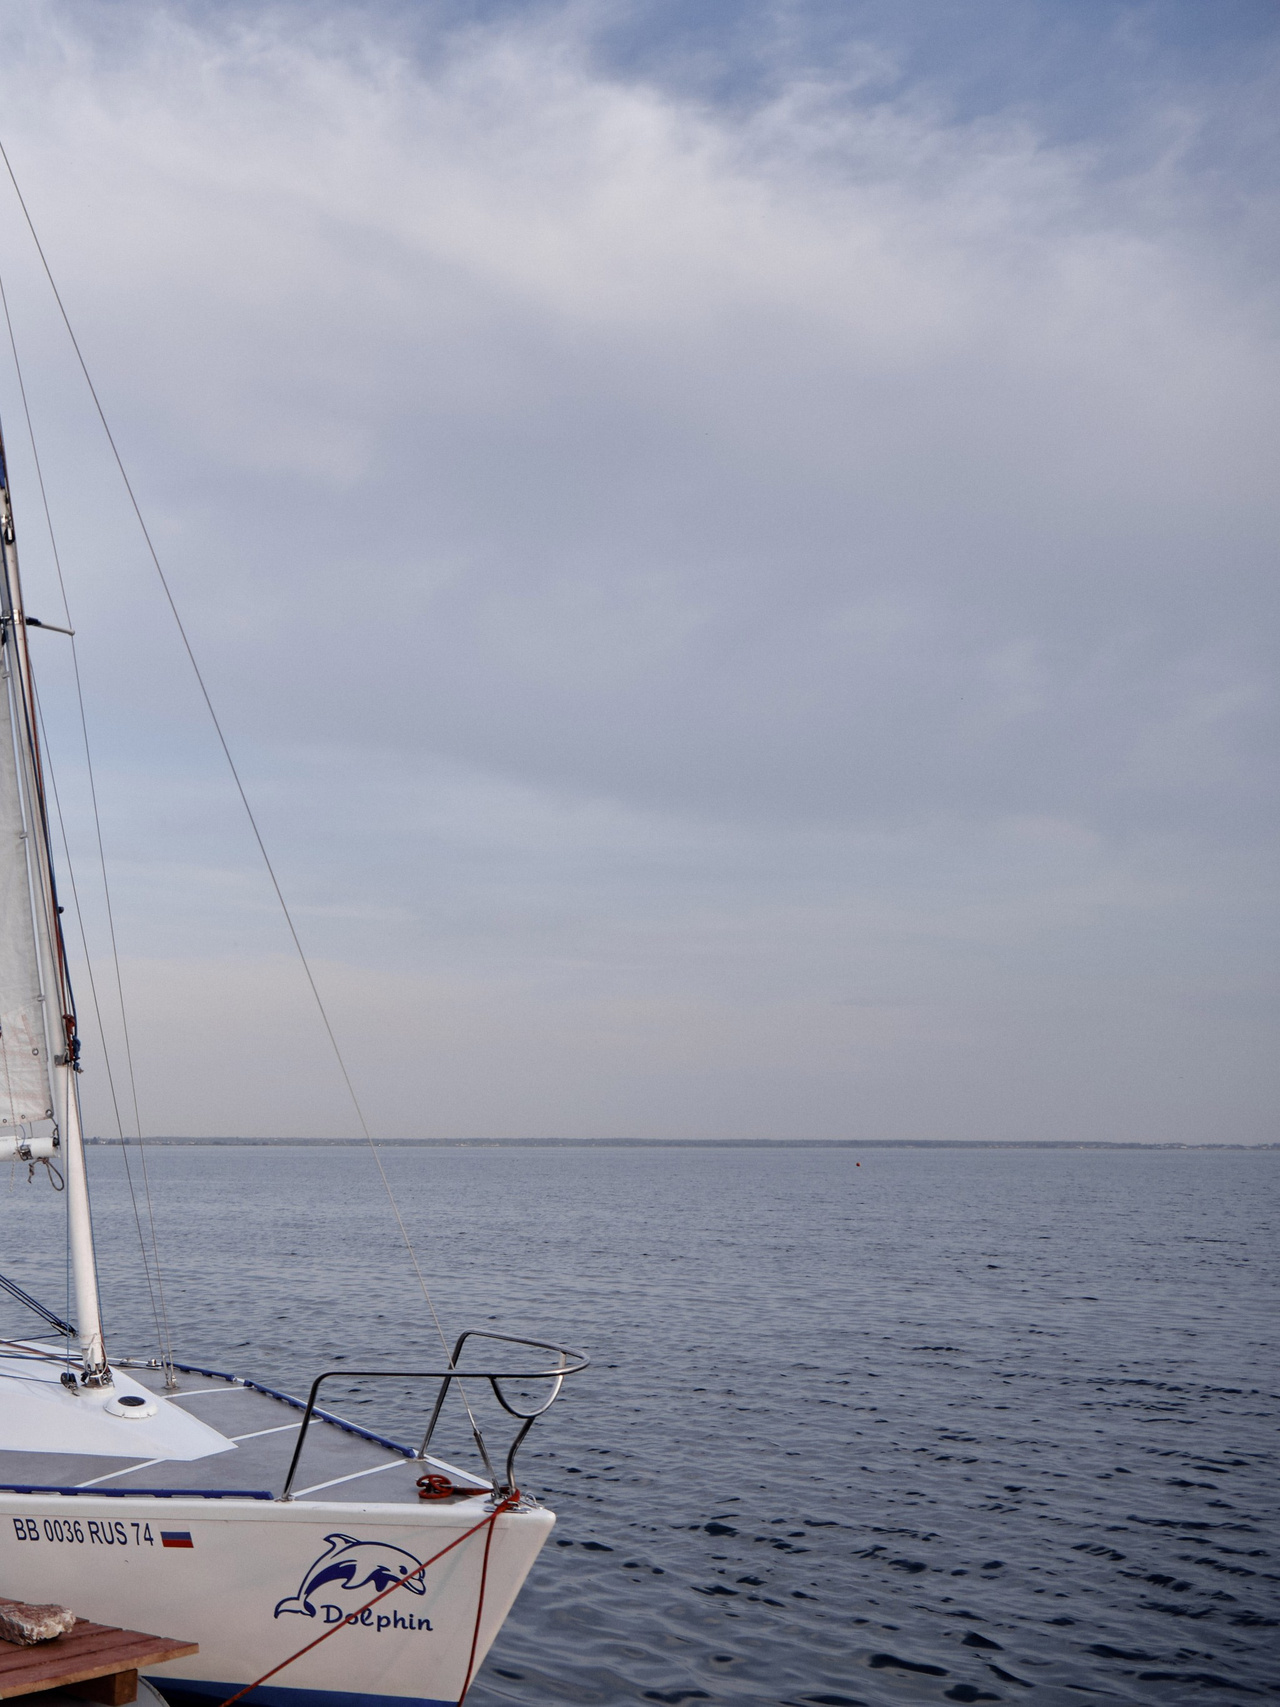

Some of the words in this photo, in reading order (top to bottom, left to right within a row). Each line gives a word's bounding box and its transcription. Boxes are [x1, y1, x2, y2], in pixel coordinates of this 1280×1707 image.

[13, 1518, 40, 1541] BB
[43, 1519, 85, 1544] 0036
[87, 1521, 128, 1546] RUS
[130, 1522, 154, 1546] 74
[320, 1604, 433, 1632] Dolphin
